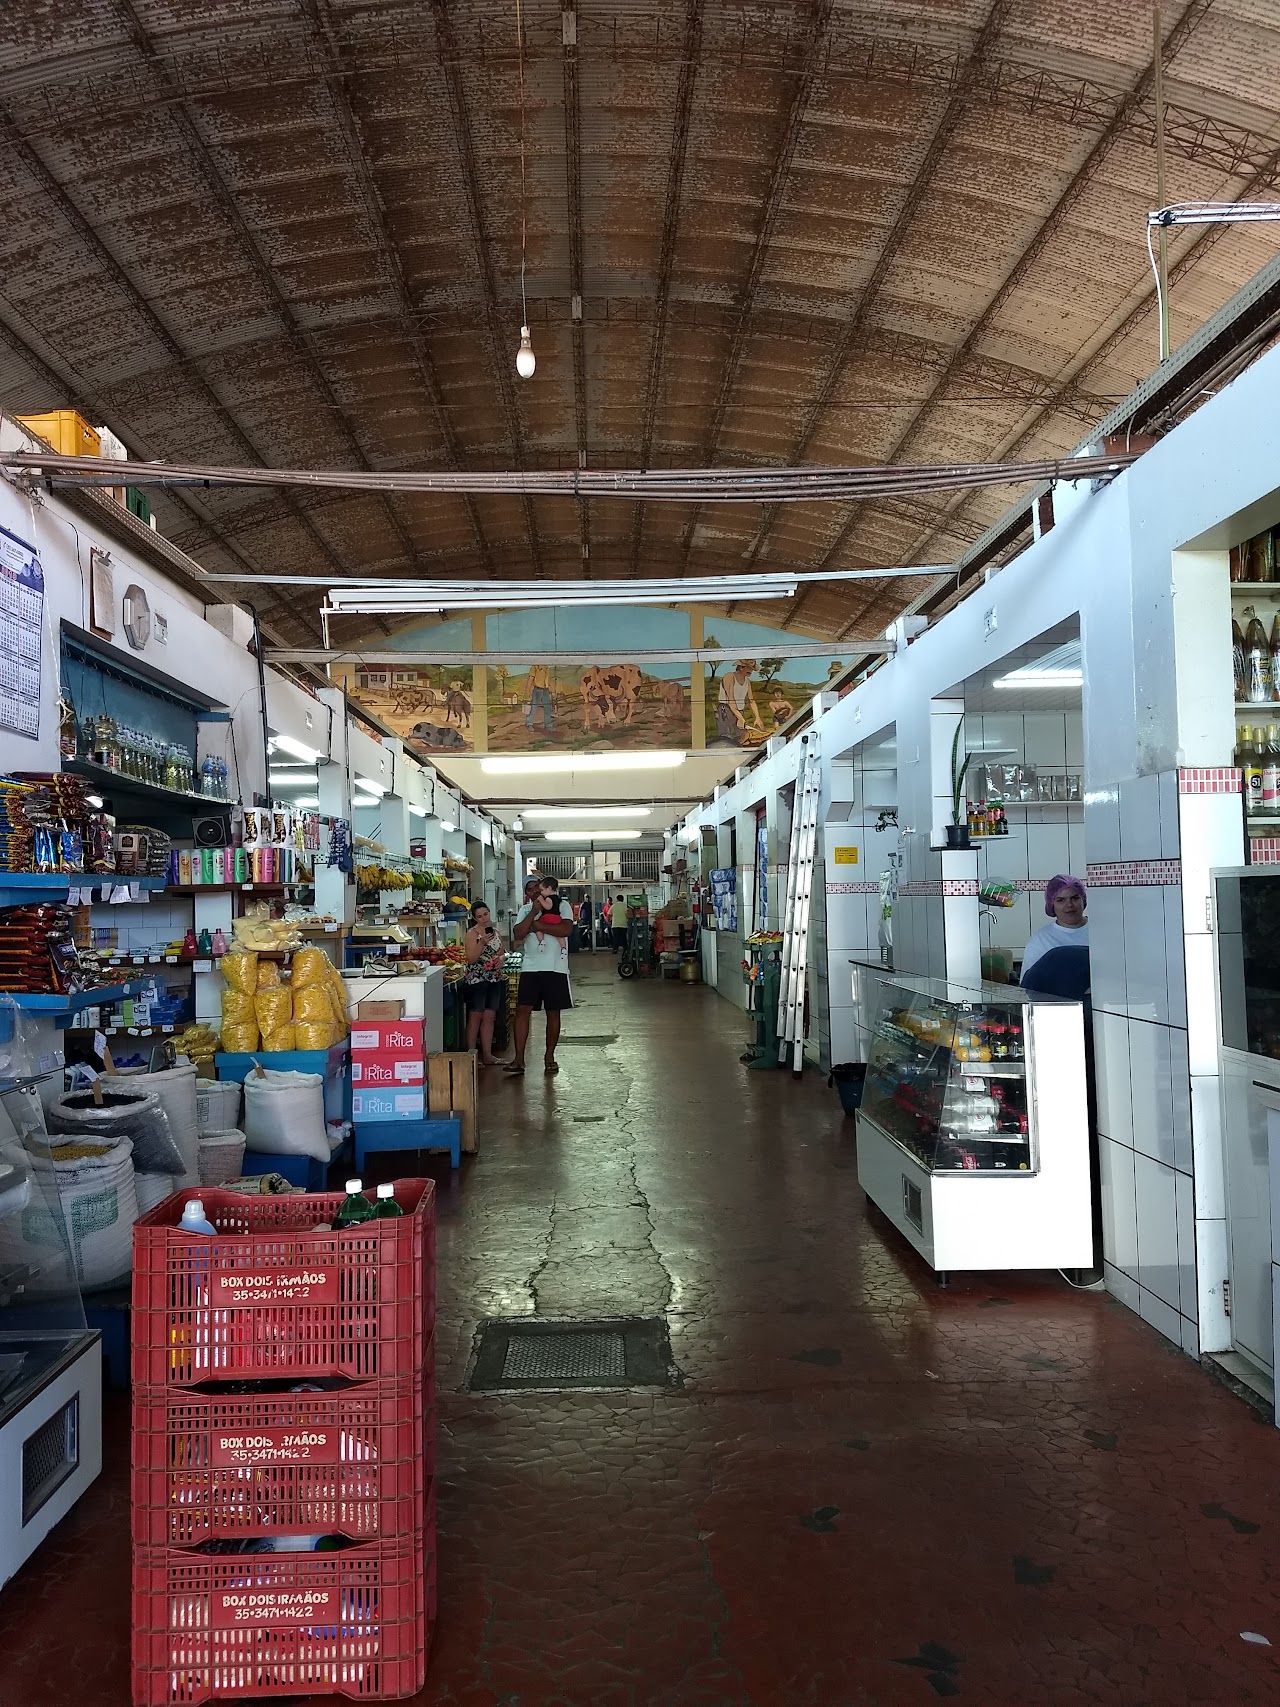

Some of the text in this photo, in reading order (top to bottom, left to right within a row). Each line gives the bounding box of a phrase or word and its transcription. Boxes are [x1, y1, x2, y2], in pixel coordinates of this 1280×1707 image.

[1252, 777, 1261, 787] 51
[390, 1032, 413, 1047] Rita
[368, 1065, 392, 1080] Rita
[368, 1098, 392, 1113] Rita
[220, 1276, 244, 1288] BOX
[246, 1275, 273, 1287] DOIS
[219, 1437, 244, 1450] BOX
[245, 1435, 274, 1448] DOIS
[222, 1588, 328, 1608] BOX DOIS IRMÃOS
